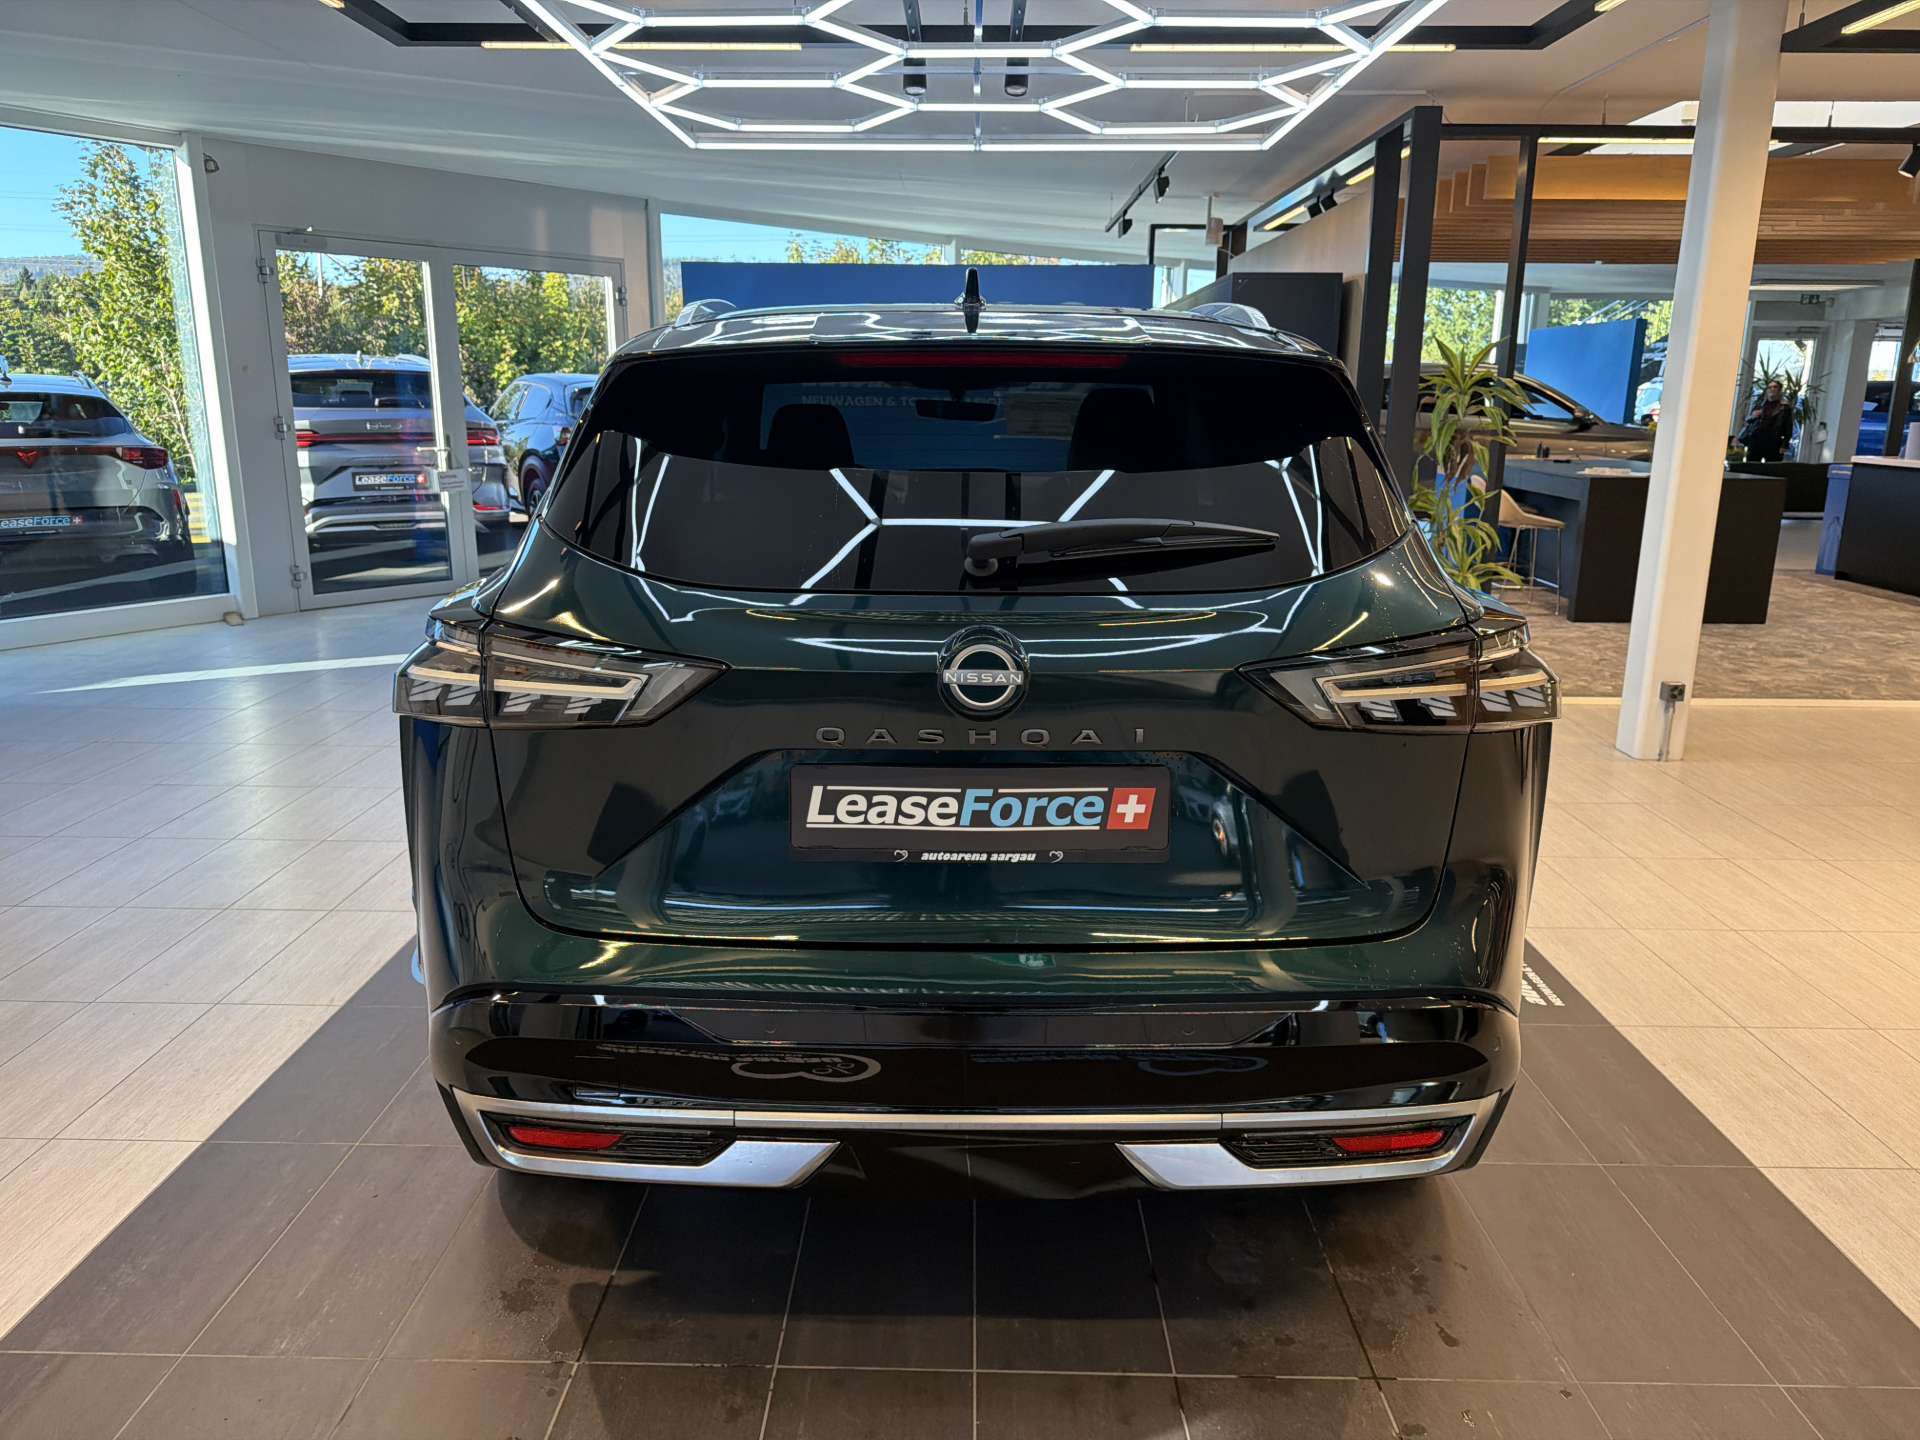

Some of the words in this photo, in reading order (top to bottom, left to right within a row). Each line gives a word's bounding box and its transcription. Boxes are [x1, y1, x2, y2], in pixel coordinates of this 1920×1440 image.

[355, 474, 416, 485] LeaseForce
[0, 516, 71, 529] easeForce
[945, 671, 1023, 684] NISSAN
[815, 726, 1146, 747] QASHQAI
[806, 785, 1105, 827] LeaseForce
[920, 851, 988, 862] autoarena
[990, 851, 1036, 863] aargau
